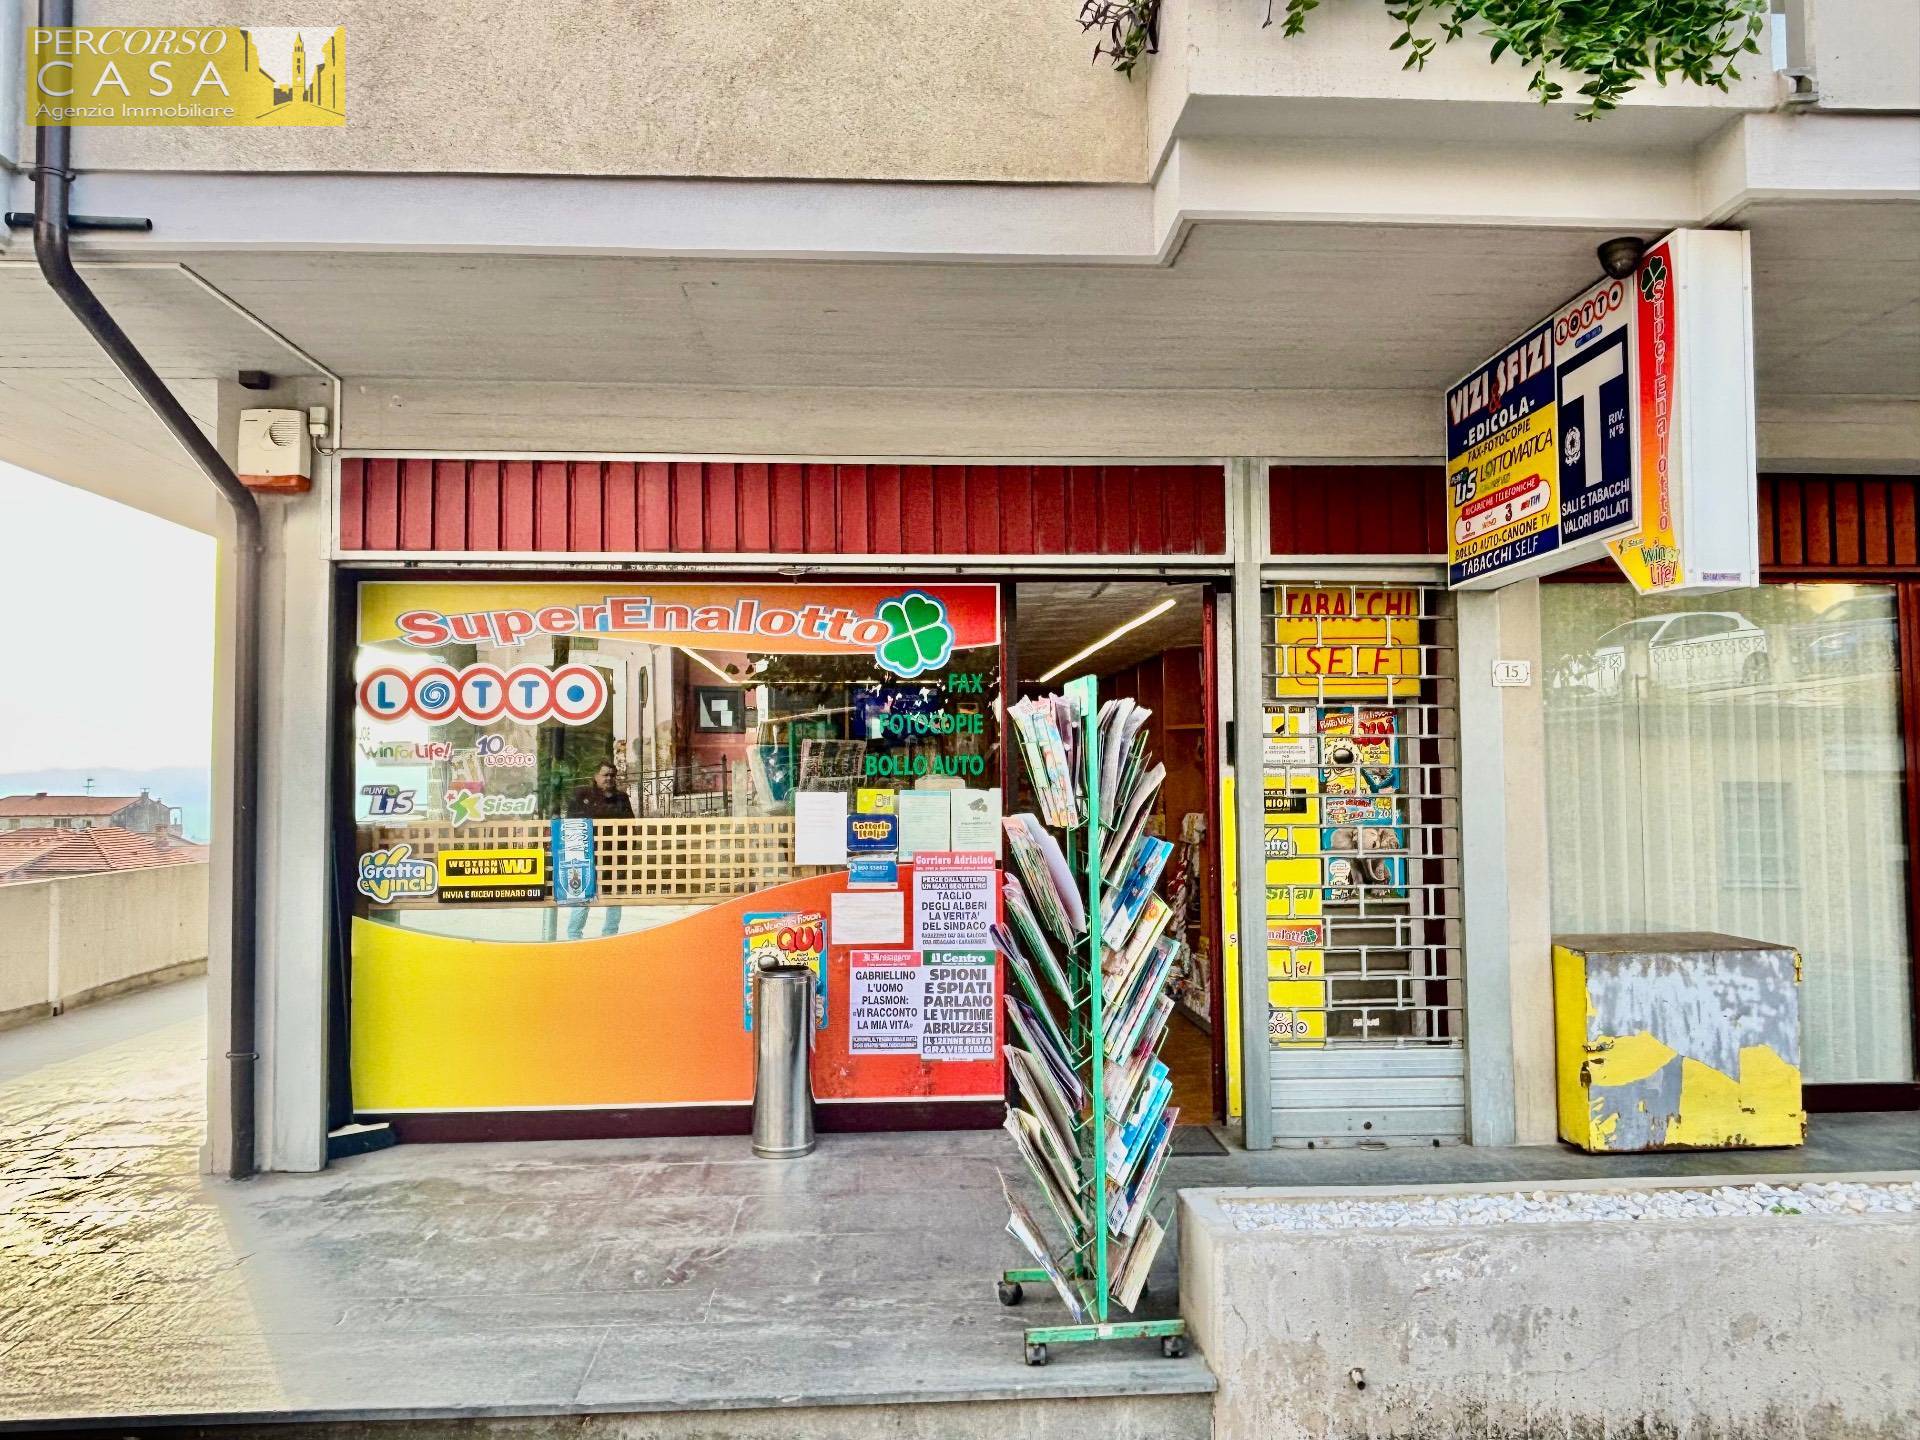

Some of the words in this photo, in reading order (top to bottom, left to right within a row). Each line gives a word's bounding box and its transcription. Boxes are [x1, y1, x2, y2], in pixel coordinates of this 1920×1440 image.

[1555, 281, 1624, 345] LOTTO
[1450, 370, 1489, 426] VIZI
[1497, 327, 1552, 398] SFIZI
[1562, 342, 1624, 488] T
[1608, 409, 1625, 426] RIV.
[1480, 428, 1553, 482] LOTTOMATICA
[1495, 478, 1536, 503] TELEFONICHE
[1562, 498, 1579, 517] SALI
[1580, 497, 1586, 510] E
[1588, 478, 1630, 506] TABACCHI
[1505, 502, 1513, 522] 3
[1564, 509, 1592, 535] VALORI
[1594, 498, 1629, 524] BOLLATI
[1455, 541, 1478, 561] BOLLO
[1541, 512, 1551, 526] TV
[1462, 546, 1512, 577] TABACCHI
[1515, 535, 1539, 558] SELF
[398, 596, 891, 646] SuperEnalotto
[1505, 665, 1519, 678] 15
[949, 673, 983, 693] FAX
[360, 667, 604, 721] LOTTO
[880, 713, 984, 735] FOTOCOPIE
[477, 736, 504, 755] 10
[485, 755, 535, 766] LOTTO
[866, 755, 927, 776] BOLLO
[933, 754, 985, 776] AUTO
[483, 795, 533, 812] Sisal
[1265, 798, 1291, 809] NION
[449, 860, 498, 868] WESTERN
[916, 856, 951, 864] Corriere
[954, 855, 993, 864] Adriatico
[363, 864, 426, 878] Gratta
[465, 867, 498, 875] UNION
[503, 859, 532, 874] WU
[443, 891, 463, 899] INVIA
[496, 889, 525, 898] DENARO
[527, 889, 541, 897] QUI
[937, 891, 972, 900] TAGLIO
[922, 902, 950, 910] DEGLI
[953, 902, 987, 910] ALBERI
[929, 912, 941, 920] LA
[943, 912, 980, 920] VERITA'
[922, 922, 941, 930] DEL
[944, 922, 986, 930] SINDACO
[943, 953, 986, 962] Centro
[856, 971, 916, 980] GABRIELLINO
[930, 969, 987, 980] SPIONI
[867, 984, 903, 992] L'UOMO
[925, 982, 934, 993] E
[937, 982, 992, 993] SPIATI
[862, 996, 909, 1005] PLASMON:
[924, 996, 993, 1007] PARLANO
[869, 1008, 918, 1017] RACCONTO
[924, 1009, 938, 1020] LE
[940, 1009, 992, 1020] VITTIME
[858, 1021, 869, 1029] LA
[871, 1021, 887, 1029] MIA
[923, 1022, 992, 1034] ABRUZZESI
[924, 1045, 992, 1054] GRAVISSIMO
